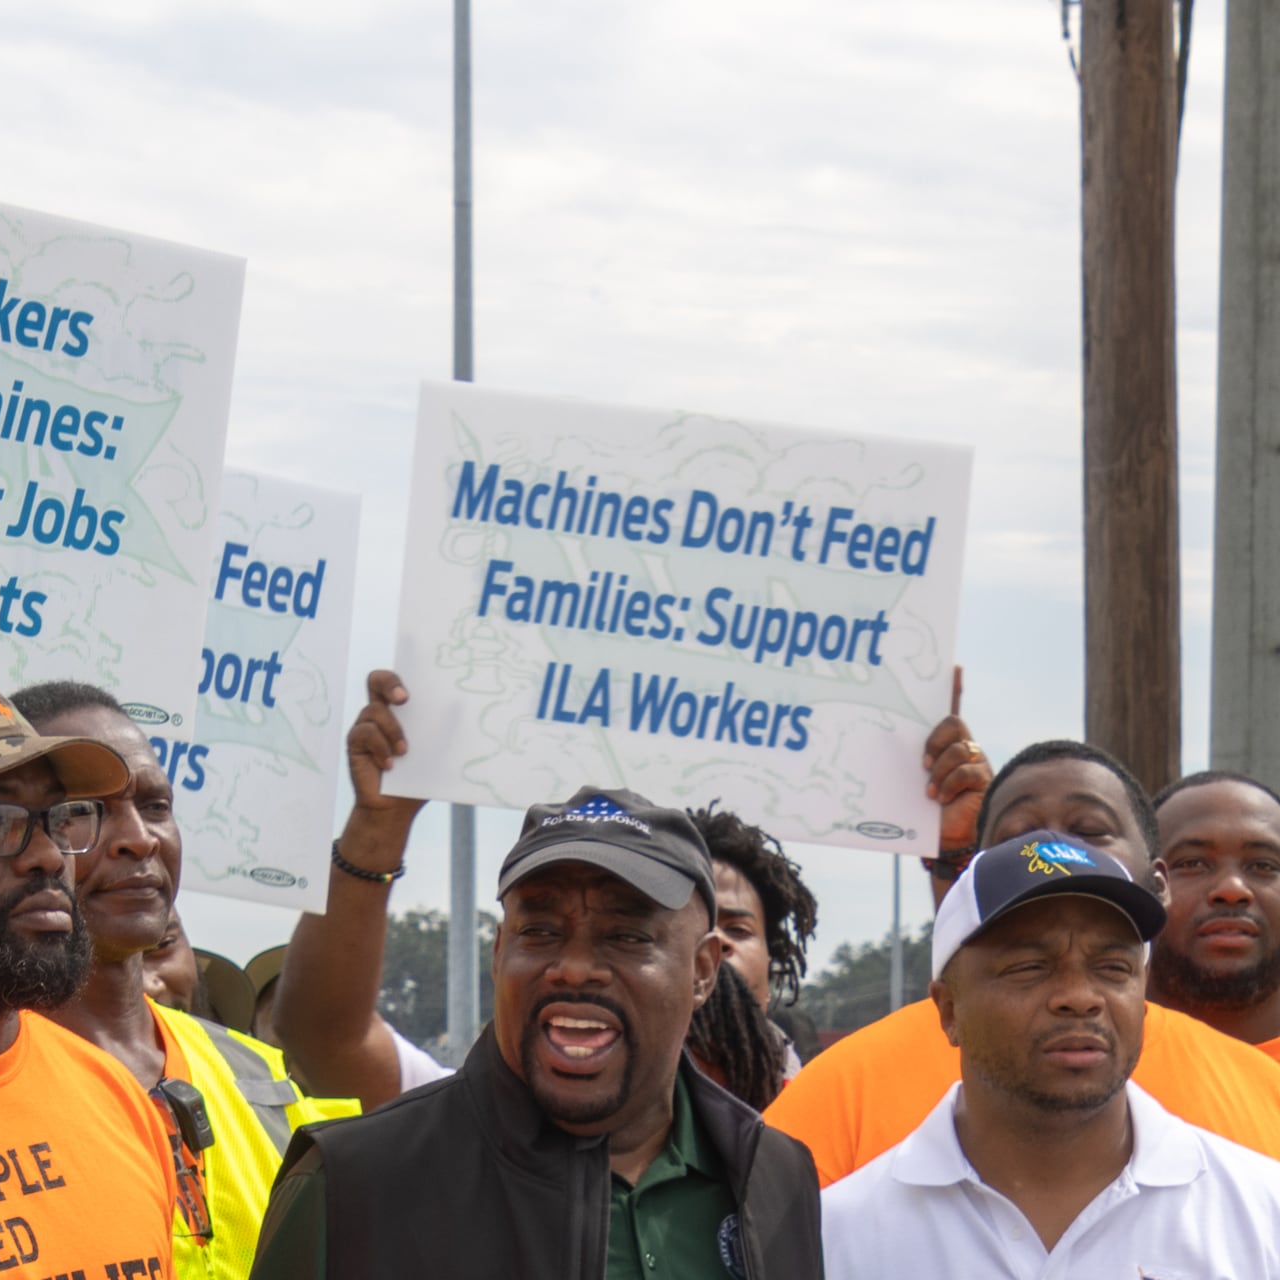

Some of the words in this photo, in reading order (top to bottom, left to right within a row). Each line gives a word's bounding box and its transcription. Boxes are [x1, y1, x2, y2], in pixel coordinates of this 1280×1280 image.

[6, 480, 125, 556] Jobs
[452, 461, 674, 544] Machines
[681, 490, 813, 561] Don't
[819, 507, 935, 576] Feed
[215, 543, 326, 619] Feed
[478, 560, 691, 641] Families:
[697, 588, 888, 667] Support
[537, 662, 610, 727] ILA
[630, 672, 811, 751] Workers
